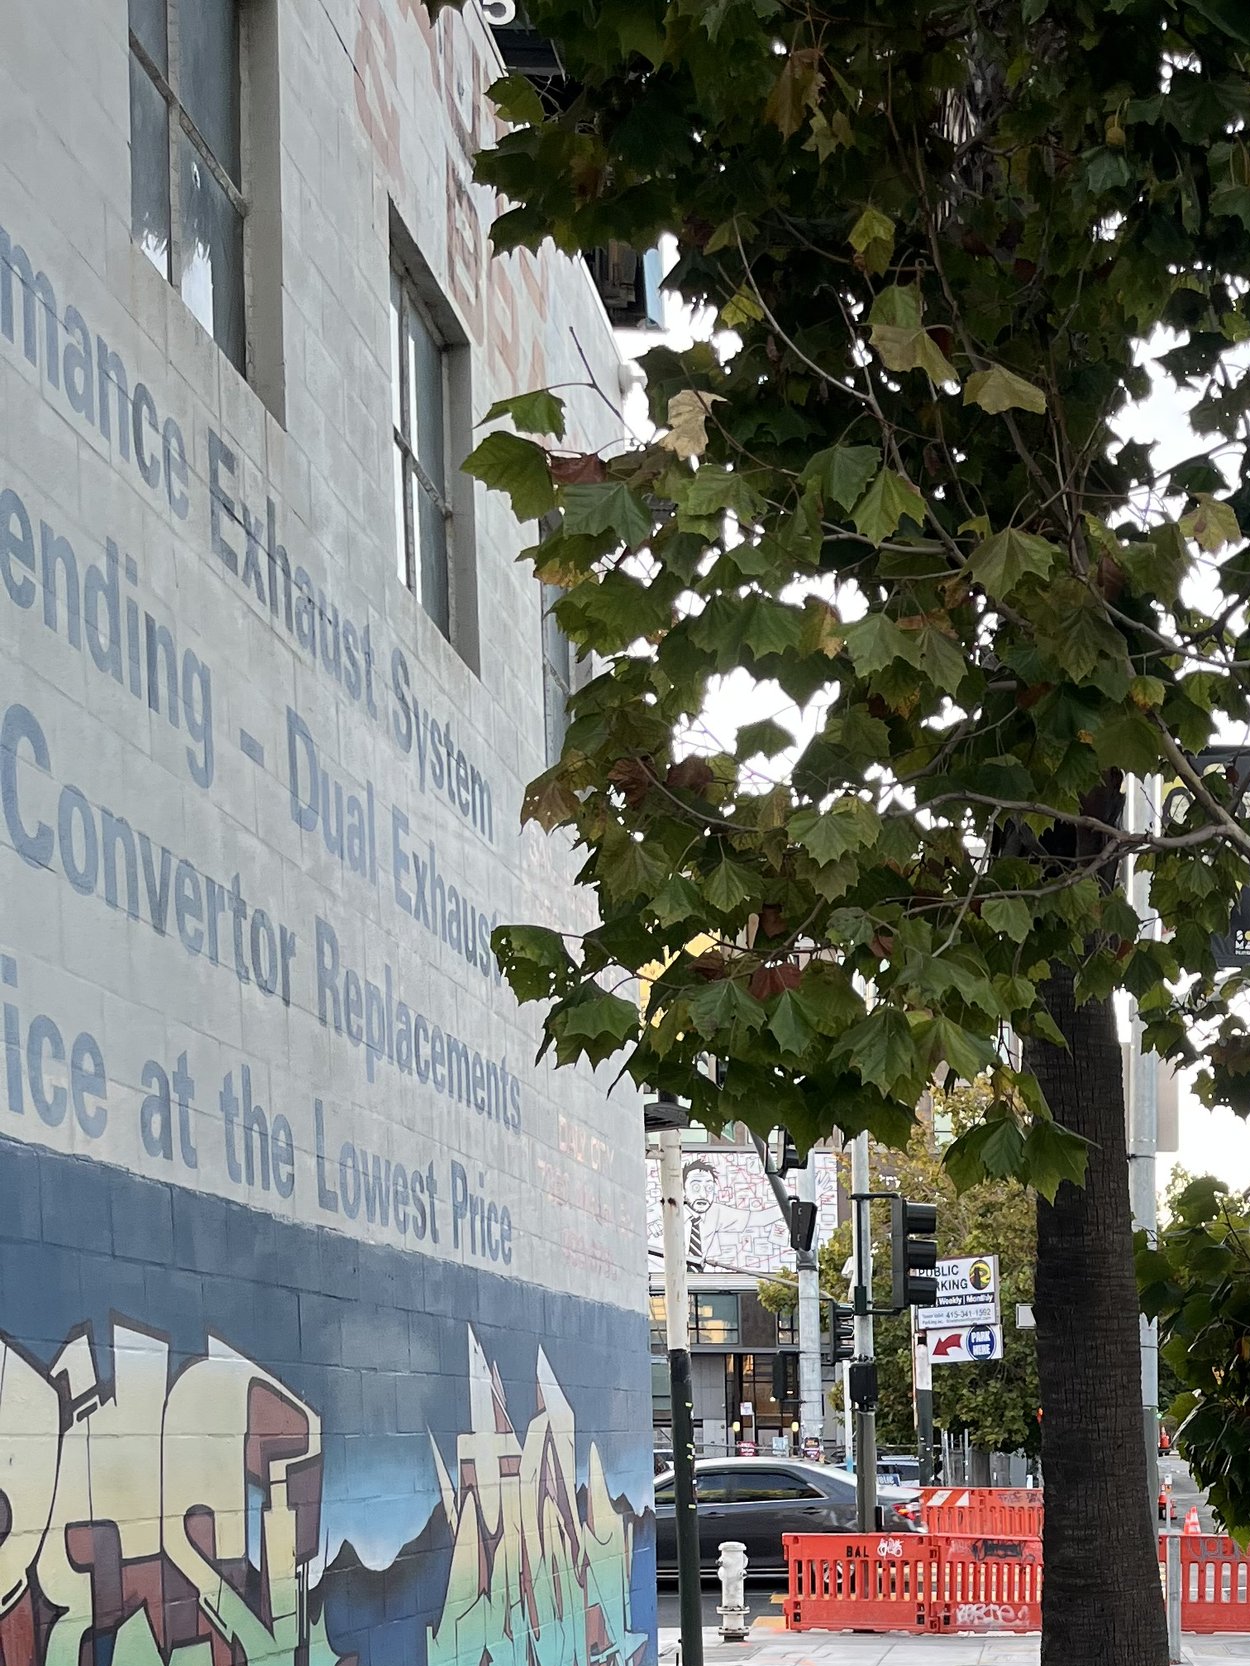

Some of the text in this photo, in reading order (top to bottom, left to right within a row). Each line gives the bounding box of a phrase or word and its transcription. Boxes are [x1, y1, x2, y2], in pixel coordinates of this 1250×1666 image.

[208, 427, 378, 721] Exhaust
[390, 645, 495, 845] System
[0, 487, 214, 789] ending
[286, 705, 377, 886] Dual
[2, 703, 522, 1136] Convertor Replacements
[2, 953, 107, 1139] ice
[140, 1048, 197, 1170] at
[219, 1063, 295, 1199] the
[315, 1097, 440, 1245] Lowest
[451, 1160, 512, 1266] Price
[918, 1264, 959, 1277] PUBLIC
[936, 1279, 968, 1291] RKING
[938, 1296, 962, 1306] Weekly
[971, 1330, 990, 1342] PARK
[972, 1344, 990, 1355] HERE
[846, 1545, 869, 1558] BAL
